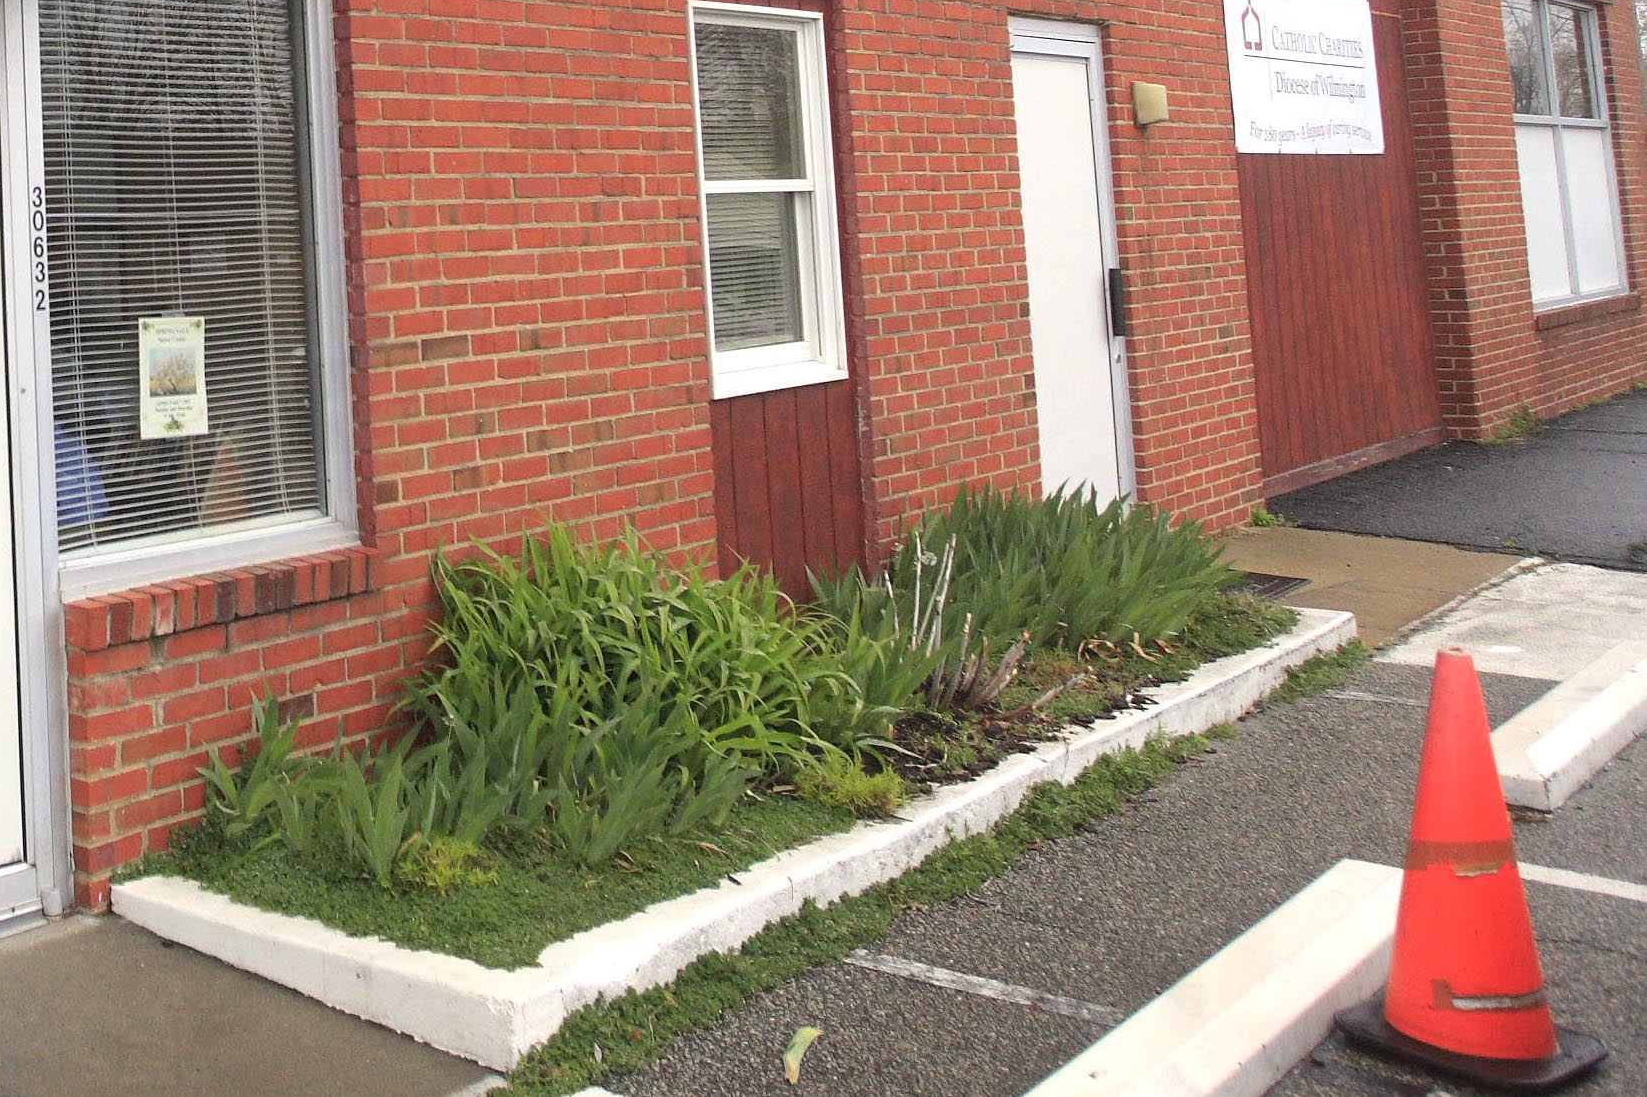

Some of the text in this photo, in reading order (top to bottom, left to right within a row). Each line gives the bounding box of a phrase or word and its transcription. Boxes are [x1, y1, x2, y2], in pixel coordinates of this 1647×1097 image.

[1275, 71, 1309, 95] Diocese
[1310, 74, 1320, 96] of
[32, 186, 47, 312] 30632
